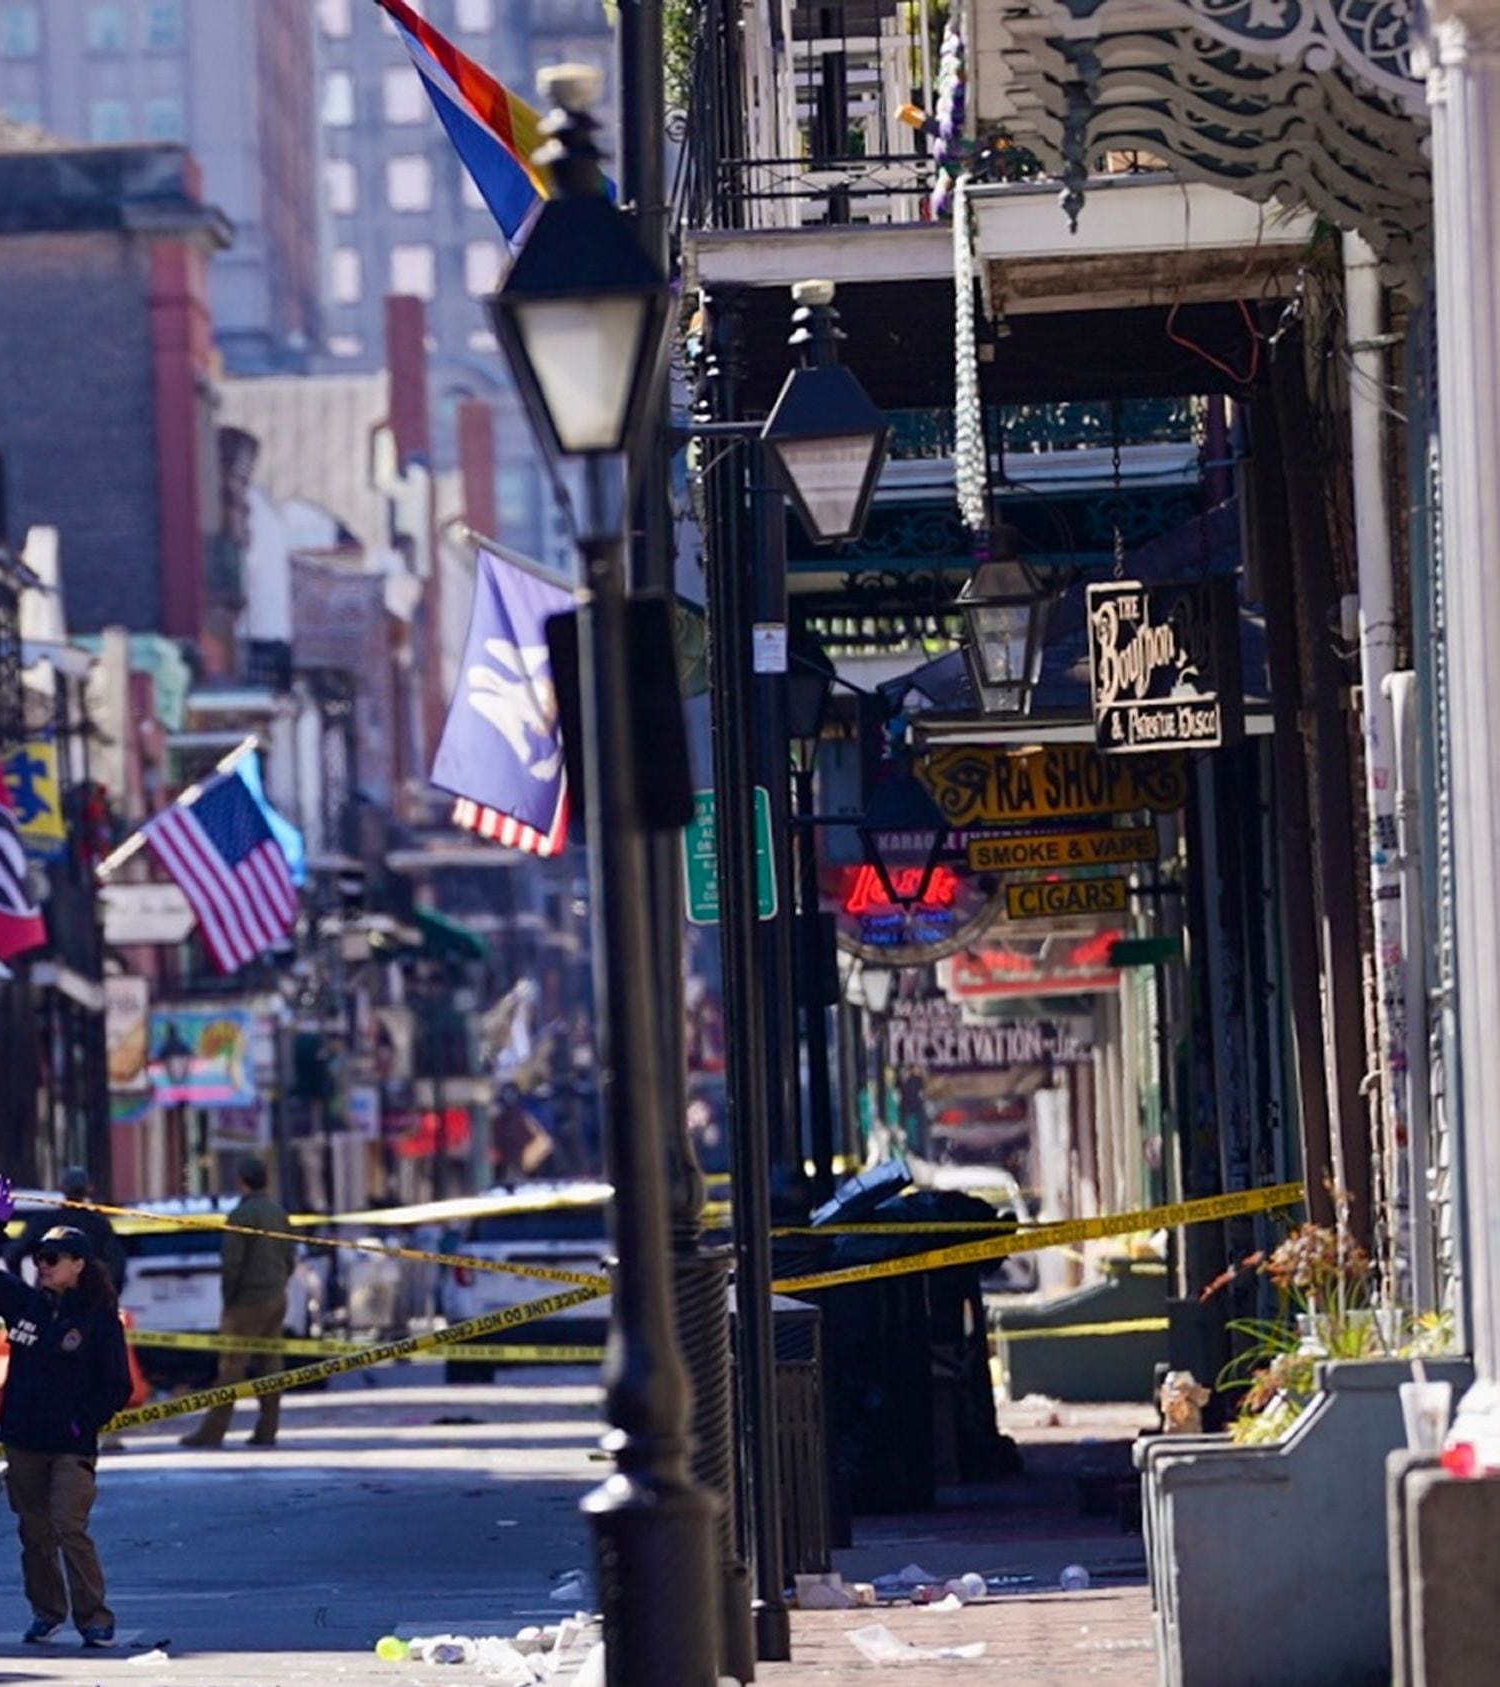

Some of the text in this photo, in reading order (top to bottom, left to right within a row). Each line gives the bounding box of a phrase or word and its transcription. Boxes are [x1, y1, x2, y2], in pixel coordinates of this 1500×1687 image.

[1117, 595, 1140, 619] THE
[1111, 711, 1124, 740] &
[995, 746, 1123, 812] RA SHOP
[878, 831, 954, 850] KARAOE
[977, 842, 1060, 866] SMOKE
[1067, 840, 1082, 859] &
[1088, 833, 1151, 859] VAPE
[1019, 881, 1117, 914] CIGARS
[523, 1298, 551, 1319] LINE
[551, 1286, 599, 1310] POLICE
[503, 1307, 522, 1324] DO
[8, 1327, 38, 1347] ERT
[163, 1396, 190, 1417] LINE
[191, 1388, 237, 1409] POLICE
[142, 1405, 160, 1422] DO
